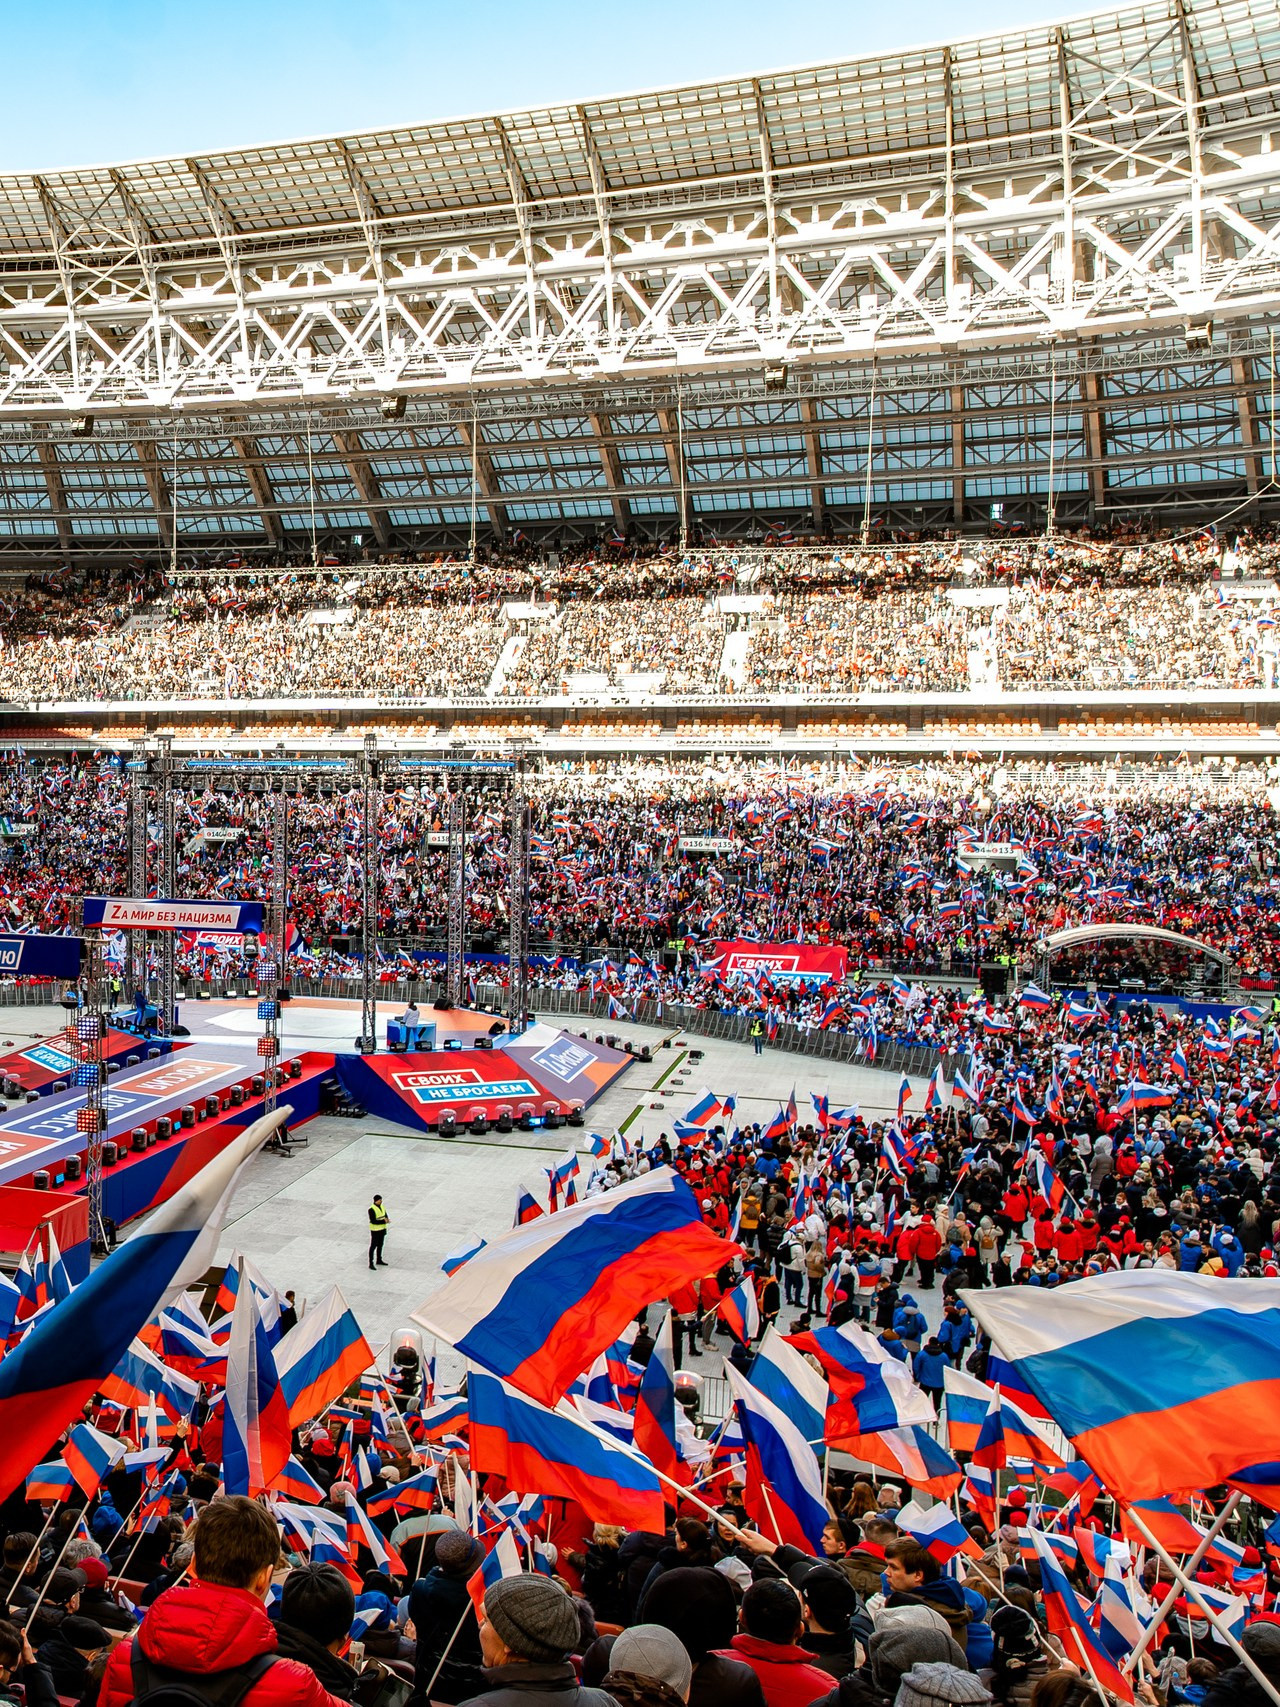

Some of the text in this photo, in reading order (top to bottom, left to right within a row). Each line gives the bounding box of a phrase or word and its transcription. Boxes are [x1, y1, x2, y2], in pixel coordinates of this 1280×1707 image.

[689, 840, 704, 848] 136
[130, 909, 155, 921] МИР
[156, 911, 176, 922] БЕЗ
[178, 911, 232, 925] НАЦИЗМА
[738, 958, 785, 971] СВОИХ
[135, 1062, 214, 1092] РОССИЯ
[407, 1073, 468, 1087] СВОИХ
[429, 1084, 526, 1099] НЕ БРОСАЕМ
[28, 1093, 138, 1133] ДОАСС
